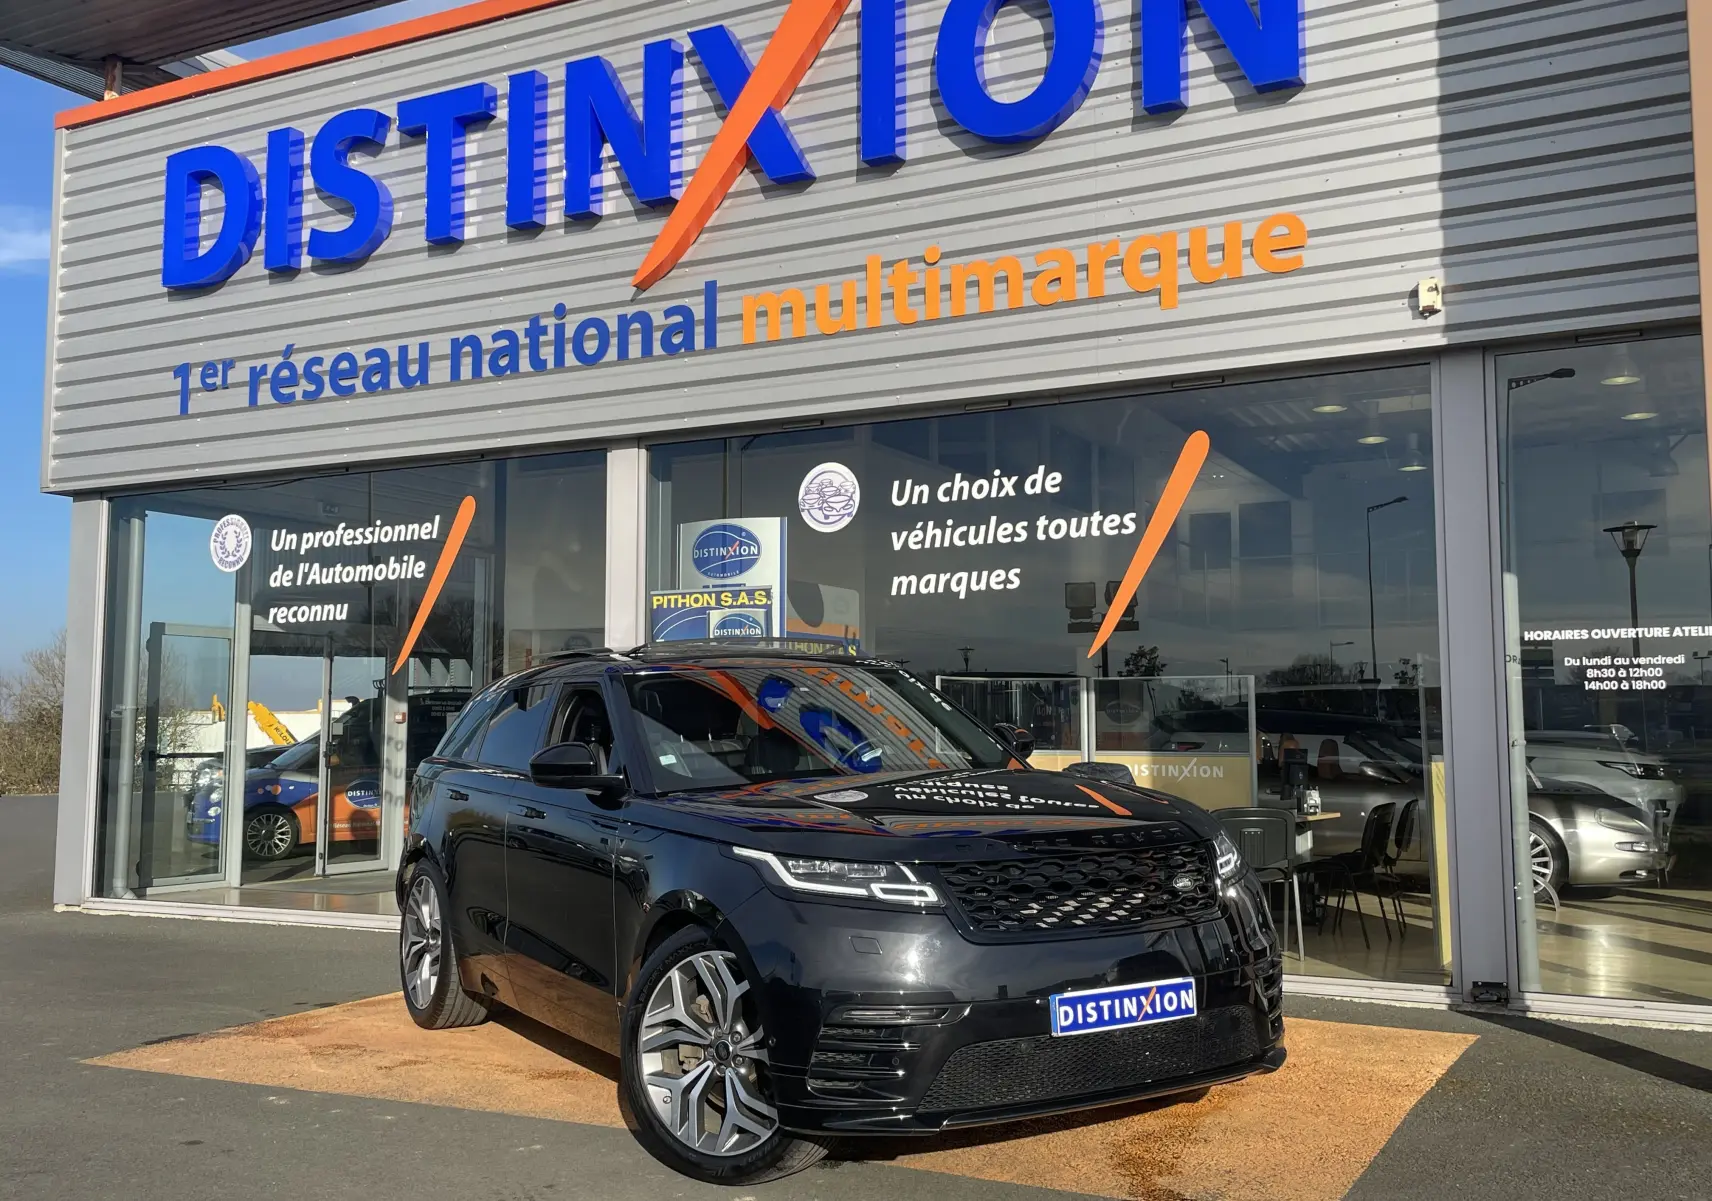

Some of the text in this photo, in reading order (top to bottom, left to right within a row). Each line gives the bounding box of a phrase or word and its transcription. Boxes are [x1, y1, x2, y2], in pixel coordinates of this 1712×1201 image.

[162, 0, 1306, 290] DISTINXION
[172, 212, 1308, 416] 1er réseau national multimarque
[891, 465, 1063, 507] Un choix de
[270, 514, 441, 555] Un professionnel
[890, 511, 1137, 551] véhicules toutes
[693, 541, 759, 559] DISTINXION
[269, 555, 425, 588] de l'Automobile
[890, 566, 1021, 600] marques
[267, 602, 349, 624] reconnu
[652, 590, 773, 609] PITHON S.A.S.
[714, 625, 762, 637] DISTINXION
[1523, 629, 1589, 641] HORAIRES
[1591, 627, 1671, 640] OUVERTURE
[1564, 654, 1685, 667] Du lundi au vendredi
[1586, 667, 1663, 678] 8h30 à 12h00
[1583, 679, 1667, 691] 14h00 à 18h00
[1059, 986, 1194, 1027] DISTINXION
